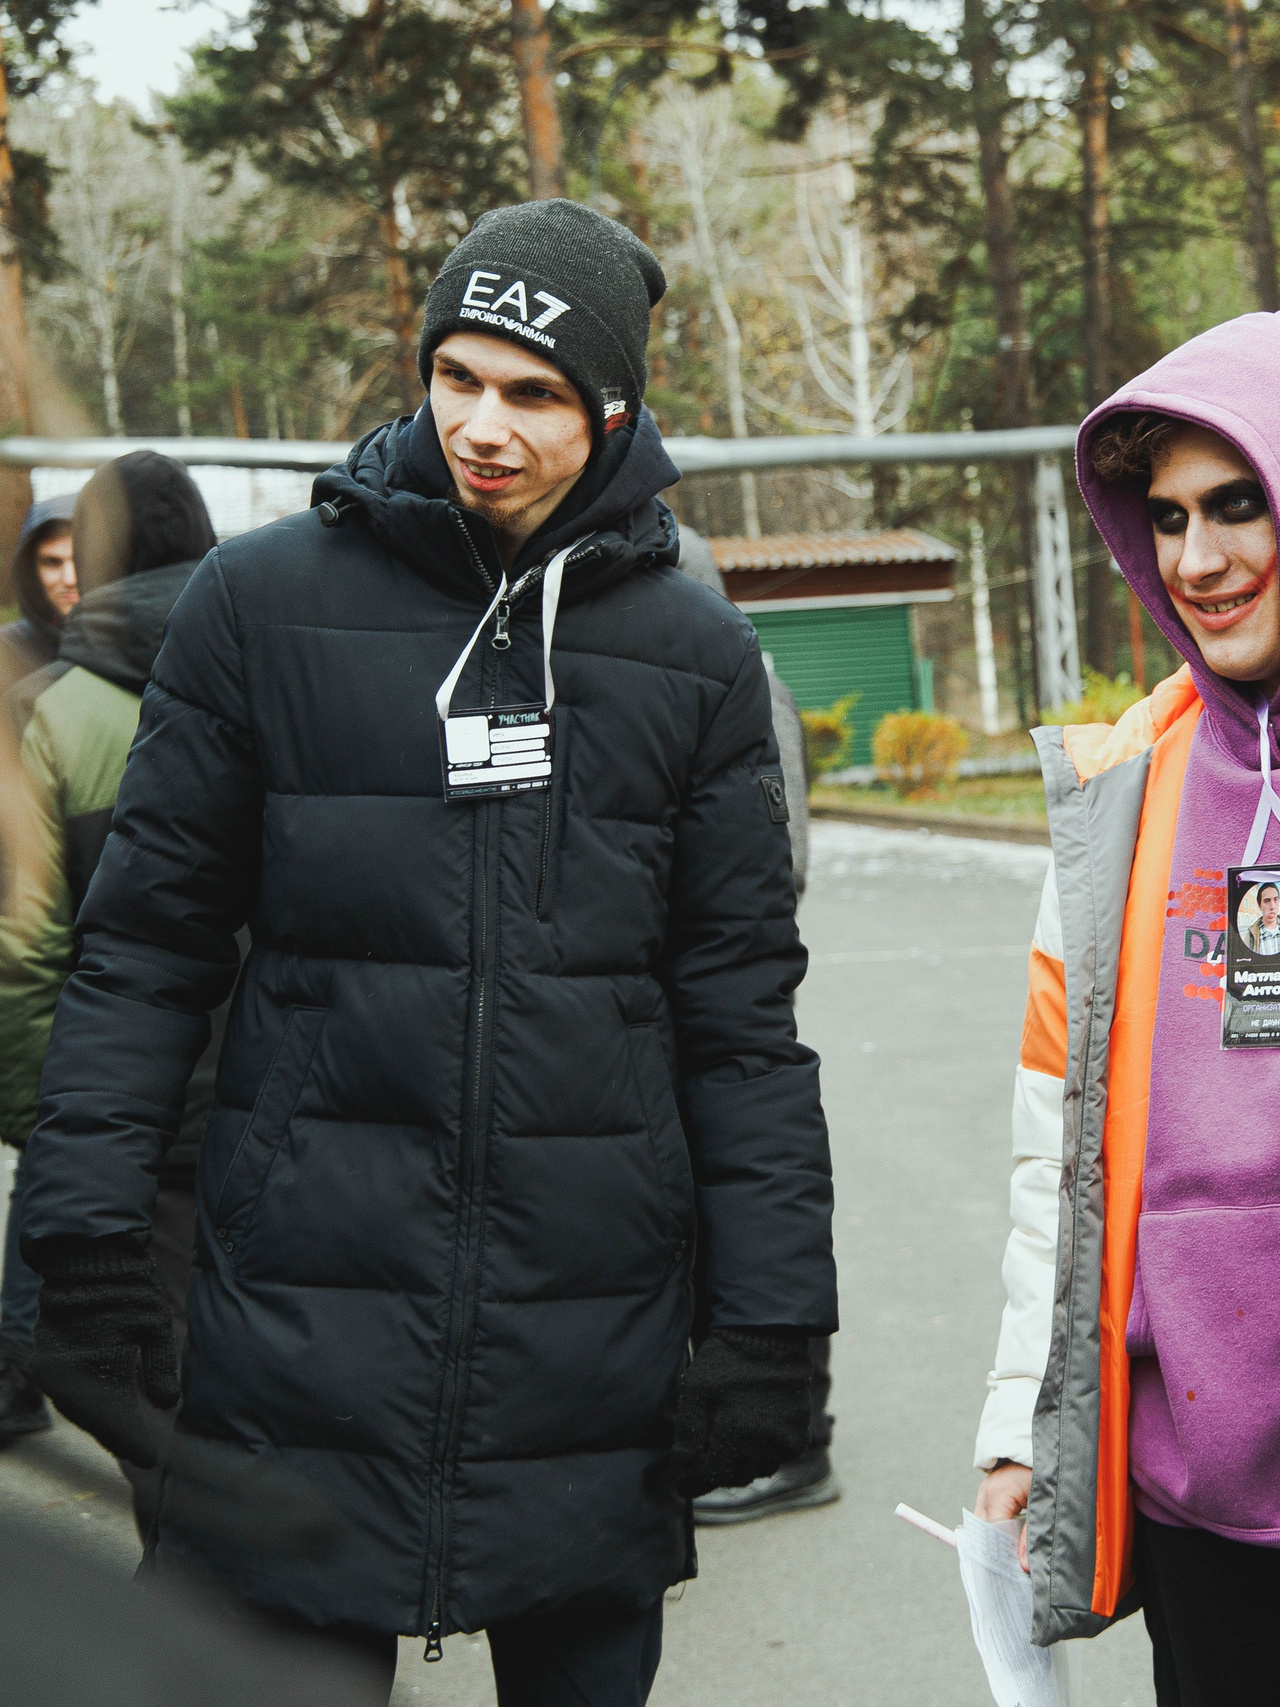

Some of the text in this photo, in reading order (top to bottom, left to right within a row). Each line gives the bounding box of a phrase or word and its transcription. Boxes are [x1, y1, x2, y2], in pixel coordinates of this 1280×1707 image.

[462, 270, 572, 330] EA7
[459, 307, 557, 349] EMPORIO ARMANI
[498, 711, 541, 726] УЧАСТНИК
